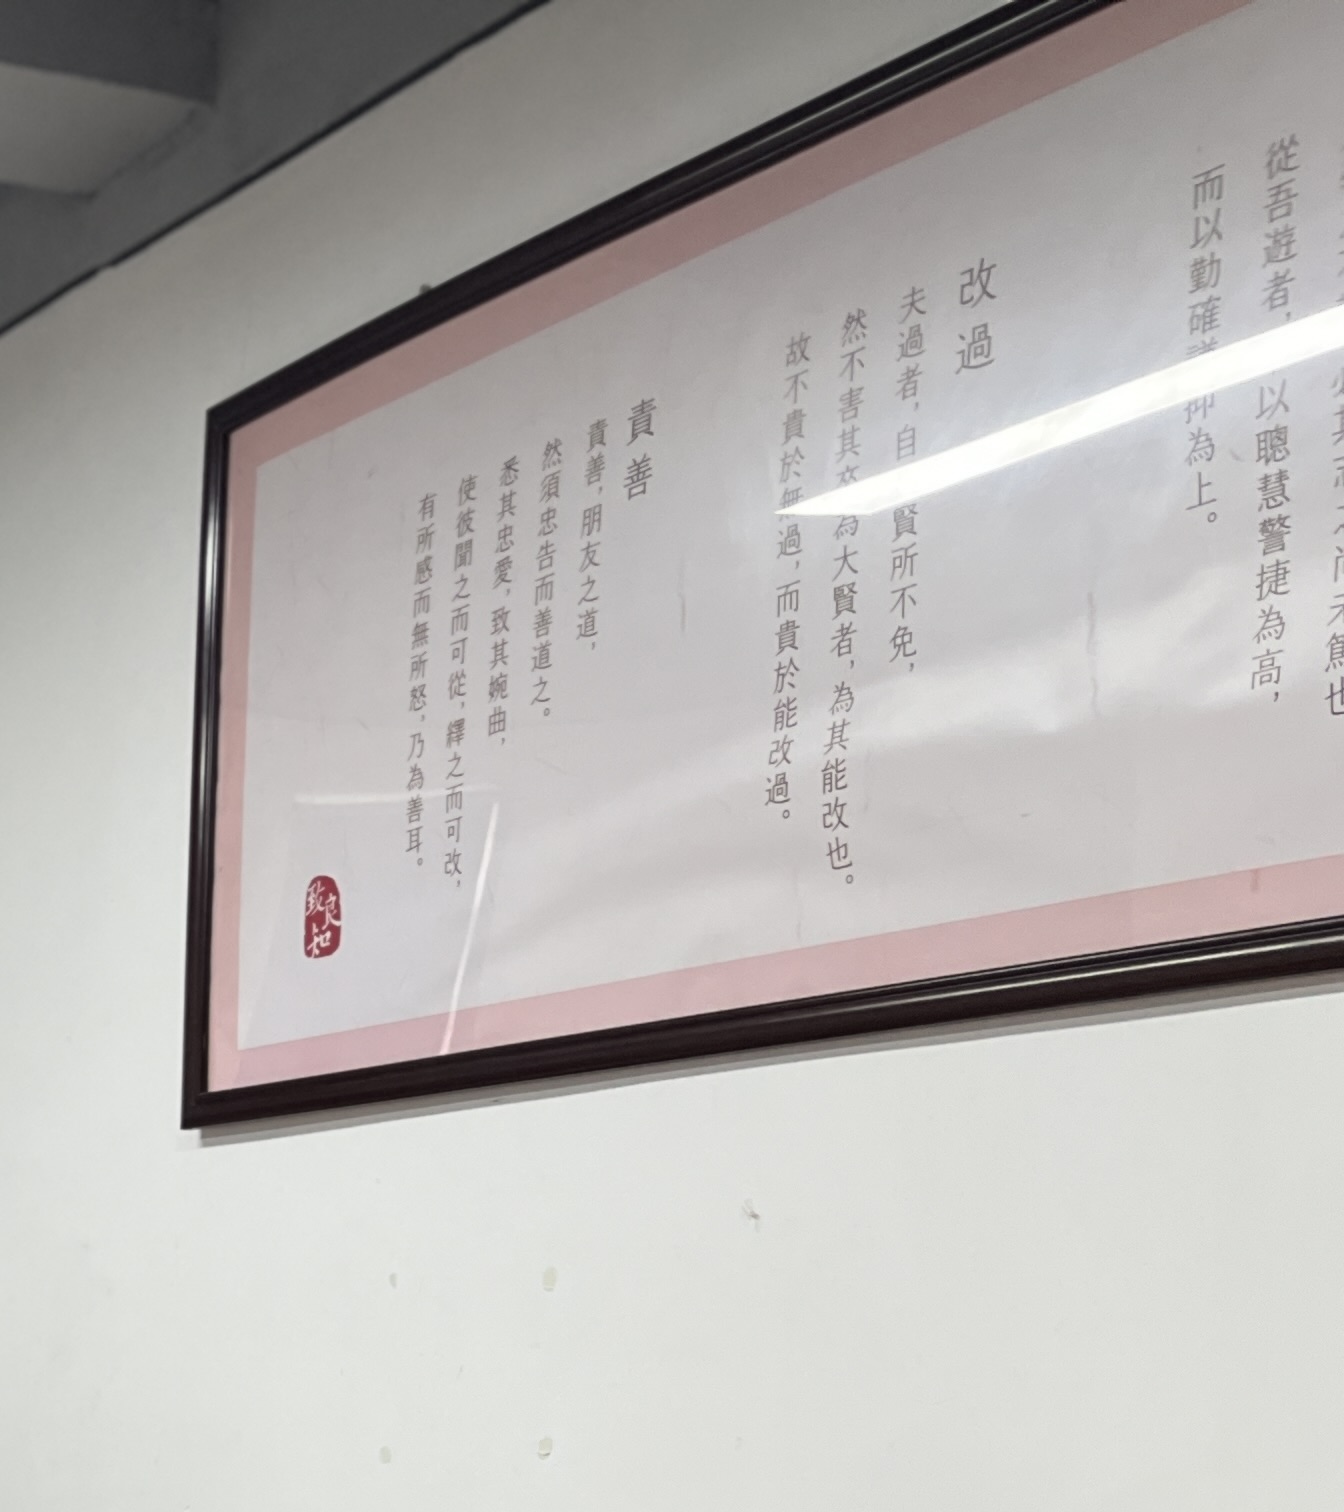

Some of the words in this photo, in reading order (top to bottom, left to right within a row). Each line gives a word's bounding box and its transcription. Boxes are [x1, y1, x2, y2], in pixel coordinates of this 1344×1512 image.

[955, 256, 997, 375] 改過
[1250, 132, 1301, 703] 從吾遊者，以聰慧警捷為高，
[531, 437, 564, 718] 然須忠告而善道之。
[576, 417, 609, 652] 責善，朋友之道，
[624, 397, 657, 501] 責善
[888, 285, 927, 673] 夫過者，自賢所不免，
